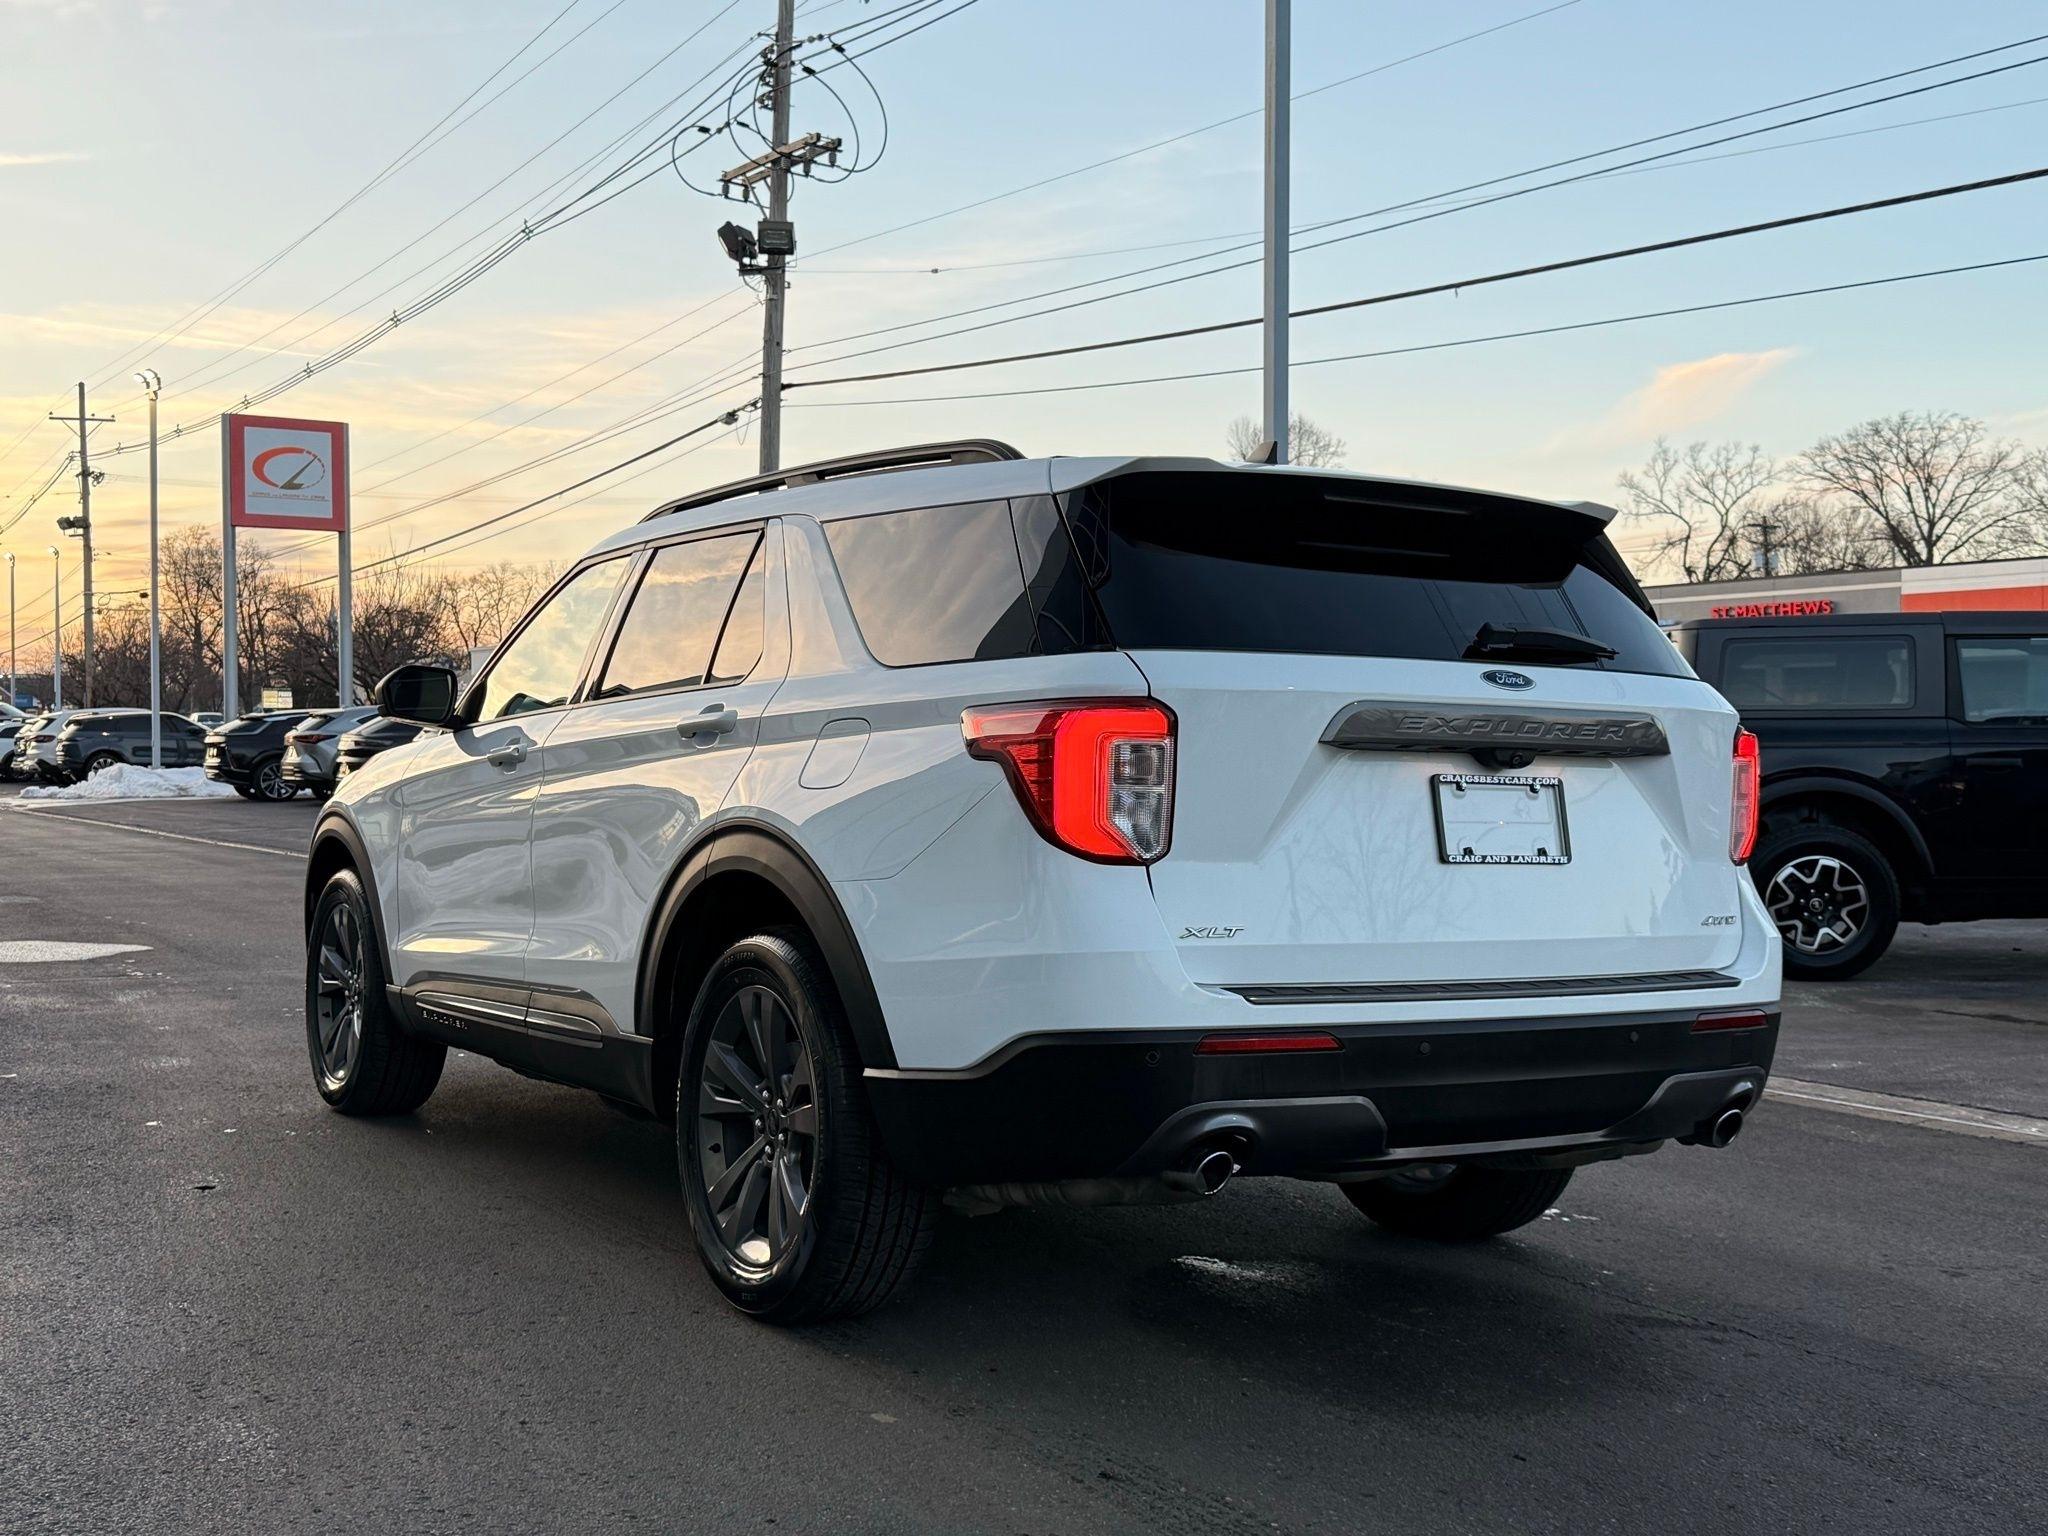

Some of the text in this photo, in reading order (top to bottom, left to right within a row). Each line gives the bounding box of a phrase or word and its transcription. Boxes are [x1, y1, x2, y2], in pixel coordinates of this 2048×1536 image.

[1734, 600, 1833, 618] MATTHEWS
[1496, 672, 1525, 685] Ford
[1396, 716, 1625, 741] EXPLORER
[1439, 774, 1559, 785] CRAIGSBESTCARS.COM
[1448, 855, 1568, 864] CRAIG AND LANDRETH
[1179, 926, 1244, 939] XLT
